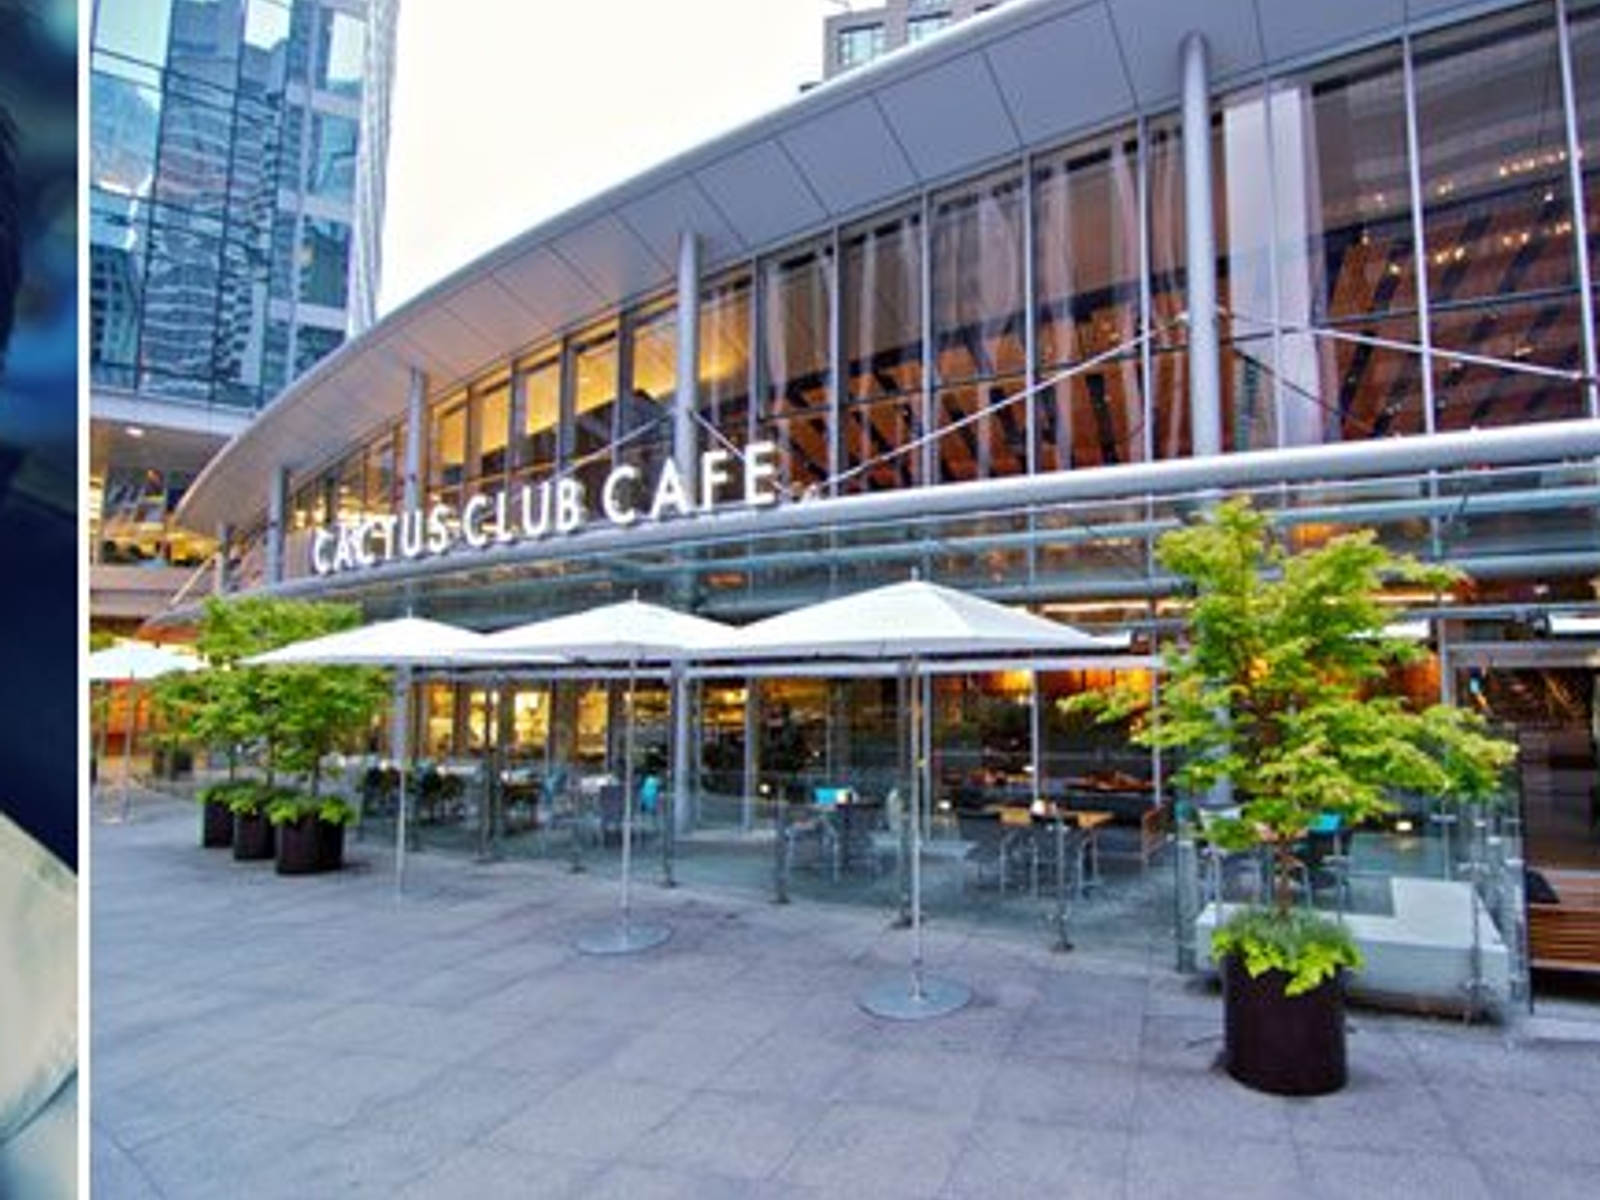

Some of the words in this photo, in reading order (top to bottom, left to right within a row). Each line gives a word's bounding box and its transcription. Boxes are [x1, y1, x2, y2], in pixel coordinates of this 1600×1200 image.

[313, 503, 451, 574] CACTUS
[463, 479, 583, 546] CLUB
[603, 442, 776, 524] CAFE
